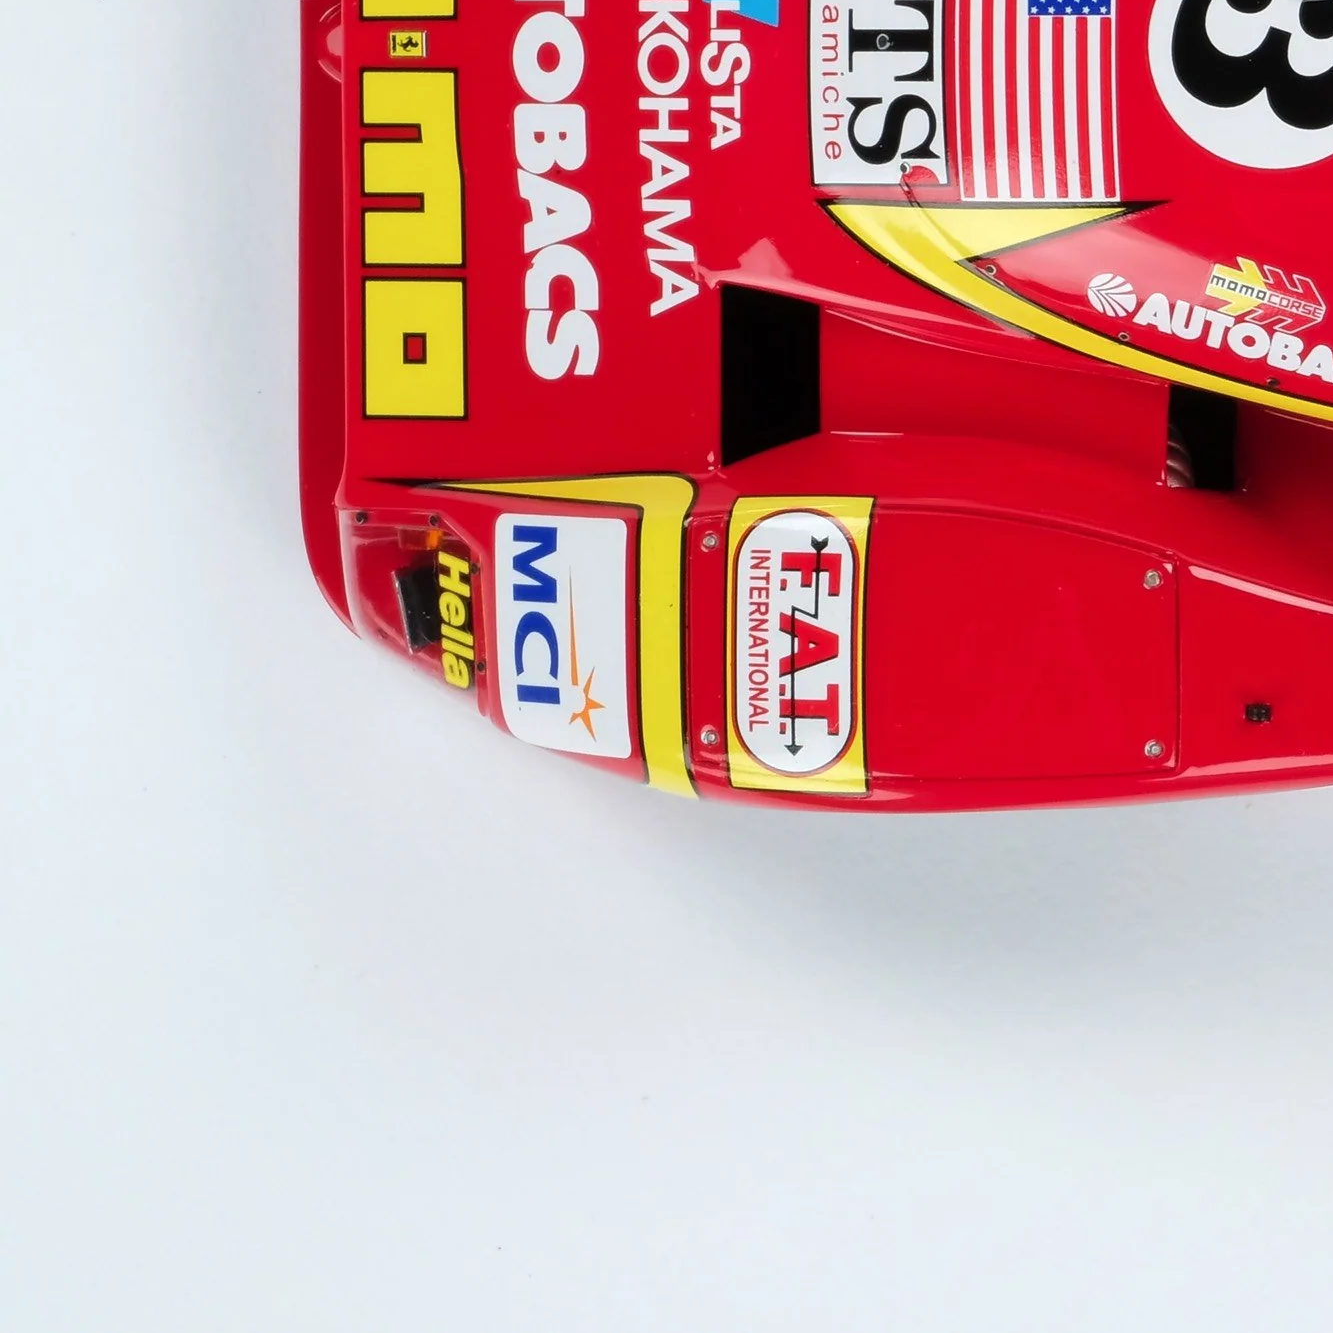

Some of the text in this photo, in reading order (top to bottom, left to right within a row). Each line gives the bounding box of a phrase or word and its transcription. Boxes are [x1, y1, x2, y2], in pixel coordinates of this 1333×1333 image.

[438, 551, 475, 690] Hella
[510, 523, 563, 707] MCI
[747, 548, 772, 733] INTERNATIONAL
